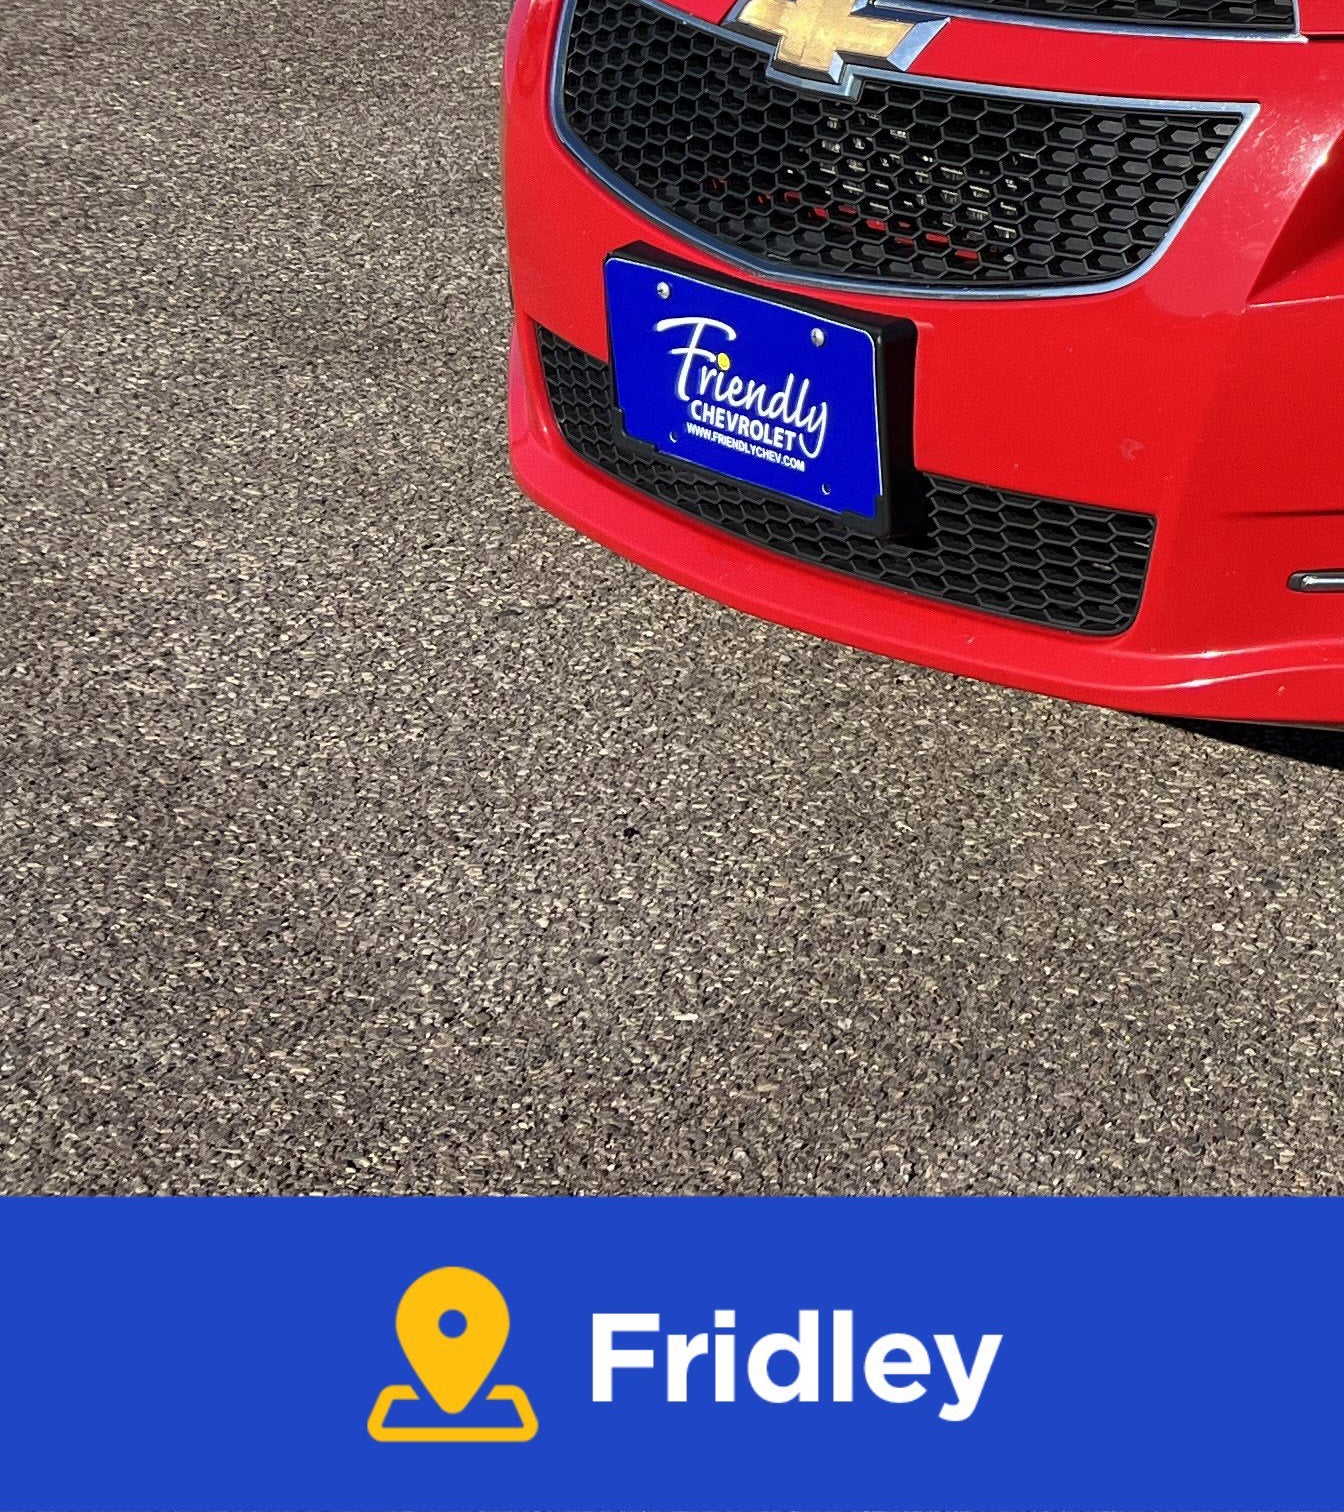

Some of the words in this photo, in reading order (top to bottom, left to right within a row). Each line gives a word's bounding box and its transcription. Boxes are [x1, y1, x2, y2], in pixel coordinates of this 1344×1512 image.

[655, 317, 828, 459] Friendly
[685, 421, 806, 472] WWW.FRIENDLYCHEV.COM
[690, 399, 797, 451] CHEVROLET
